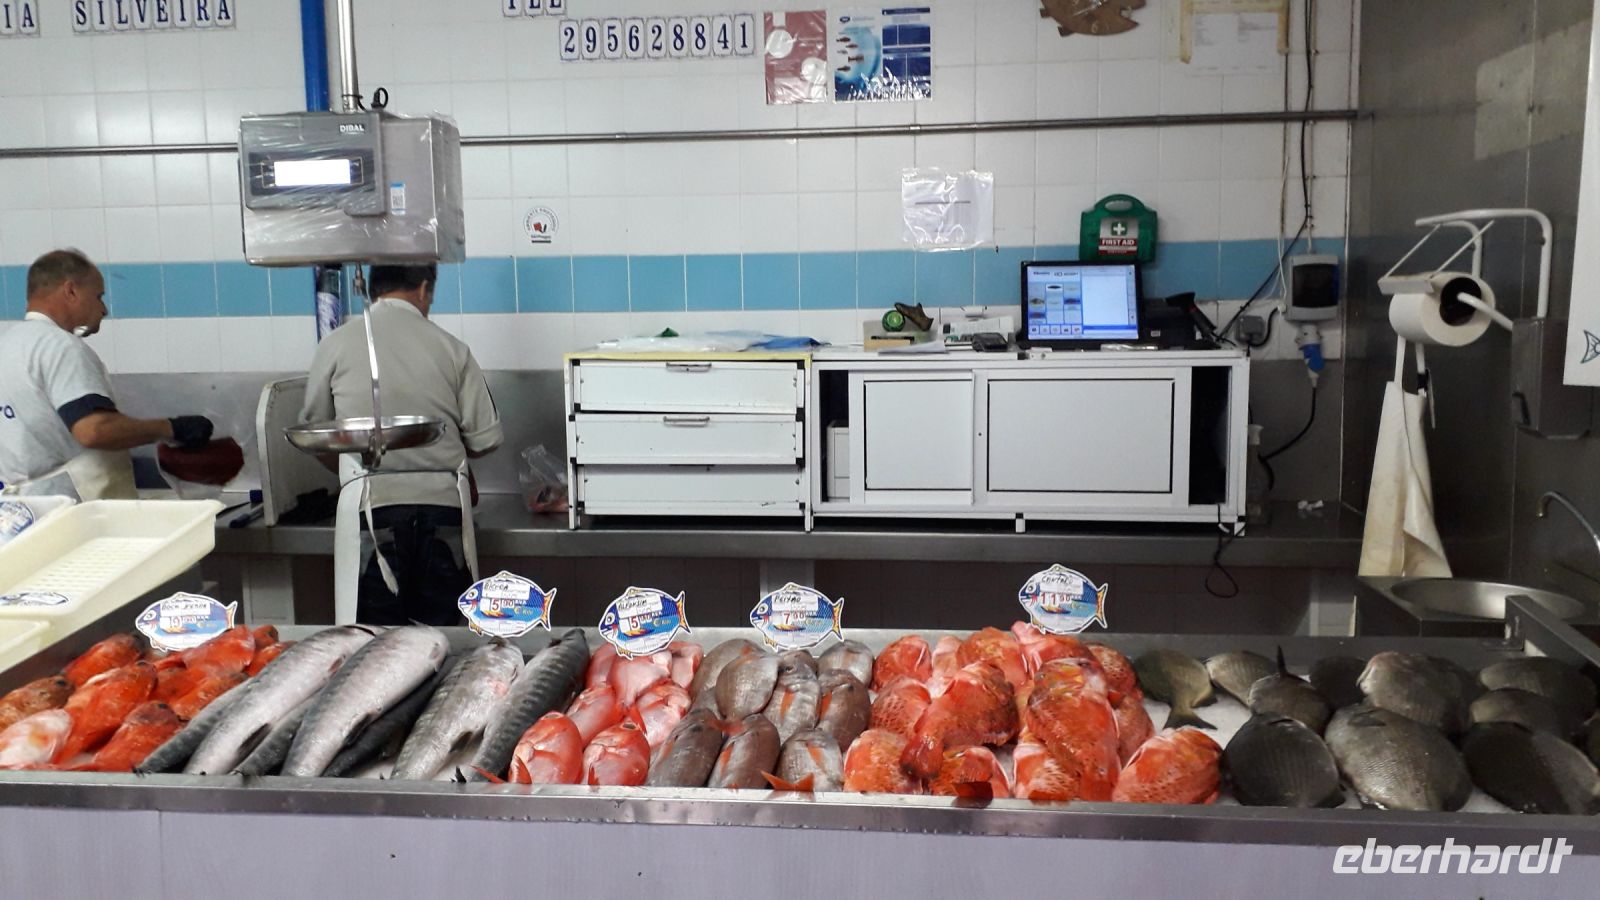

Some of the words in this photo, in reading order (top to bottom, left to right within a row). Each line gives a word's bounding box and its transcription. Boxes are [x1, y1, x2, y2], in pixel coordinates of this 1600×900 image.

[74, 0, 231, 25] SILVEIRA
[563, 22, 748, 53] 295628841
[339, 124, 365, 132] DIBAL
[492, 599, 500, 611] 5
[630, 615, 639, 628] 5
[783, 611, 790, 624] 7
